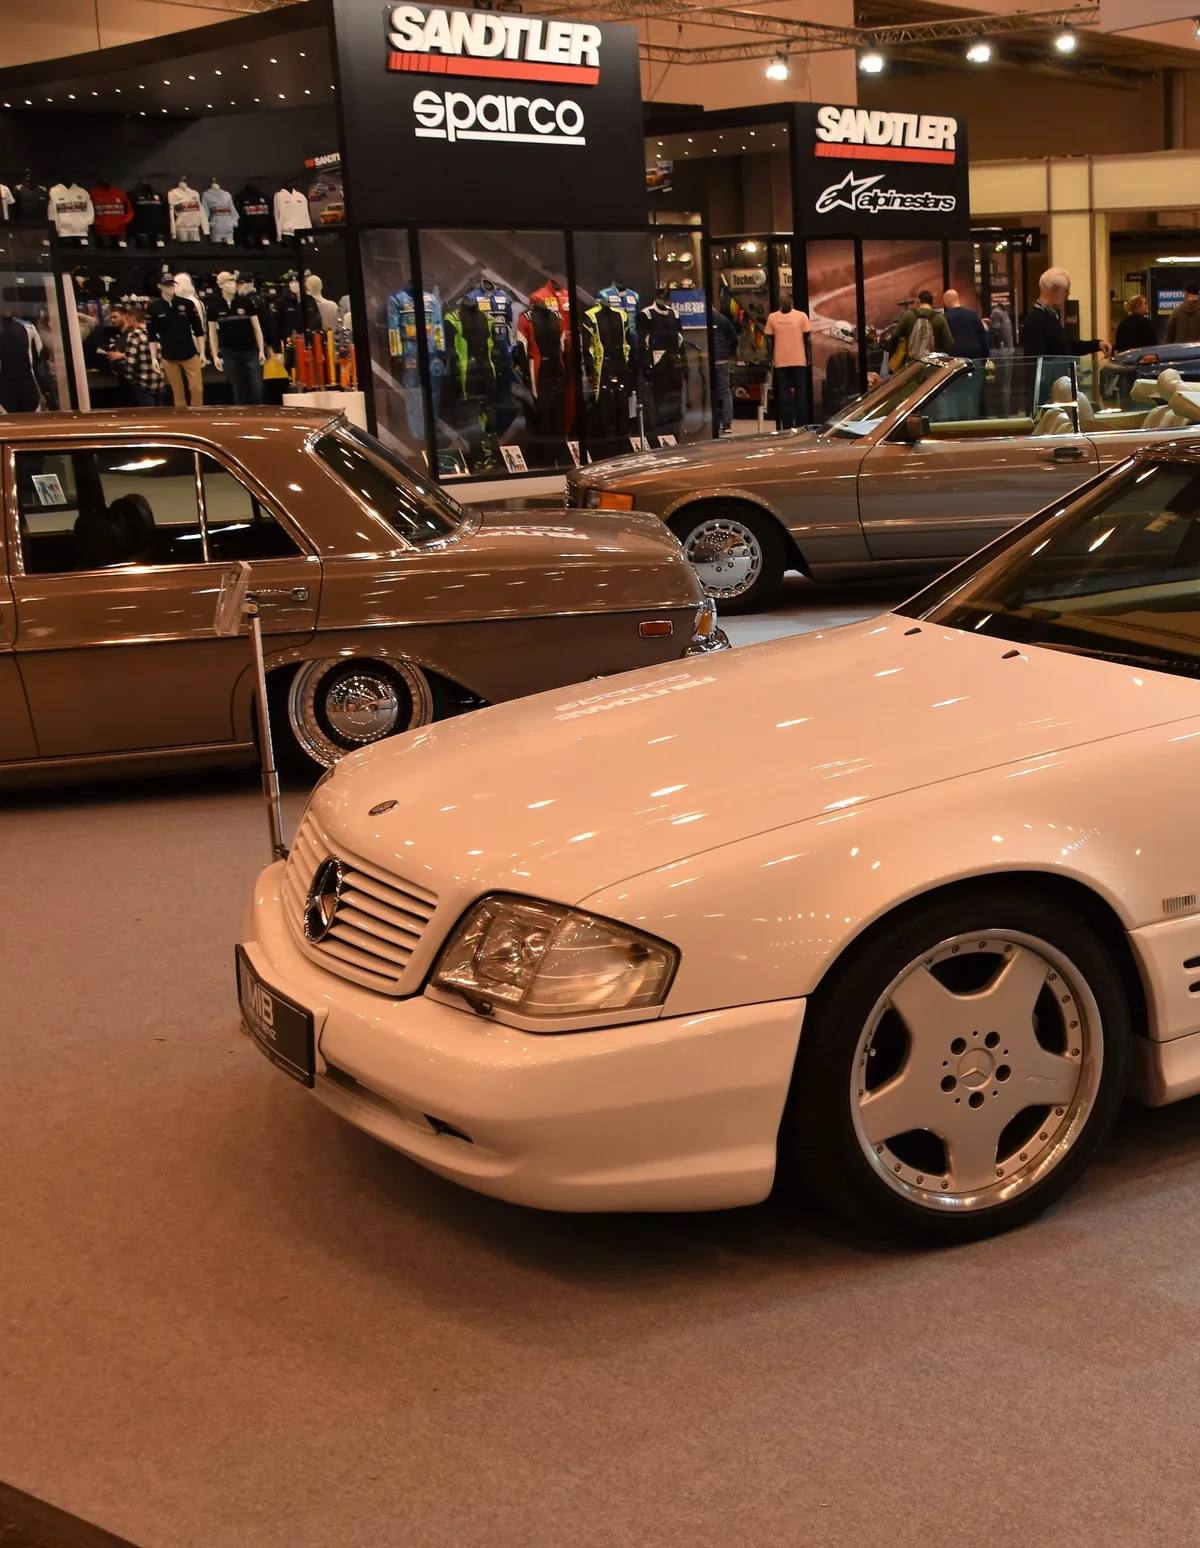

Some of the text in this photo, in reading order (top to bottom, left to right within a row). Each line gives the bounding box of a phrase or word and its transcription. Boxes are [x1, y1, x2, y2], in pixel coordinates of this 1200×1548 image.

[388, 5, 602, 67] SANDTLER
[413, 89, 585, 142] sparco
[815, 105, 958, 151] SANDTLER
[857, 189, 957, 213] alpinestars
